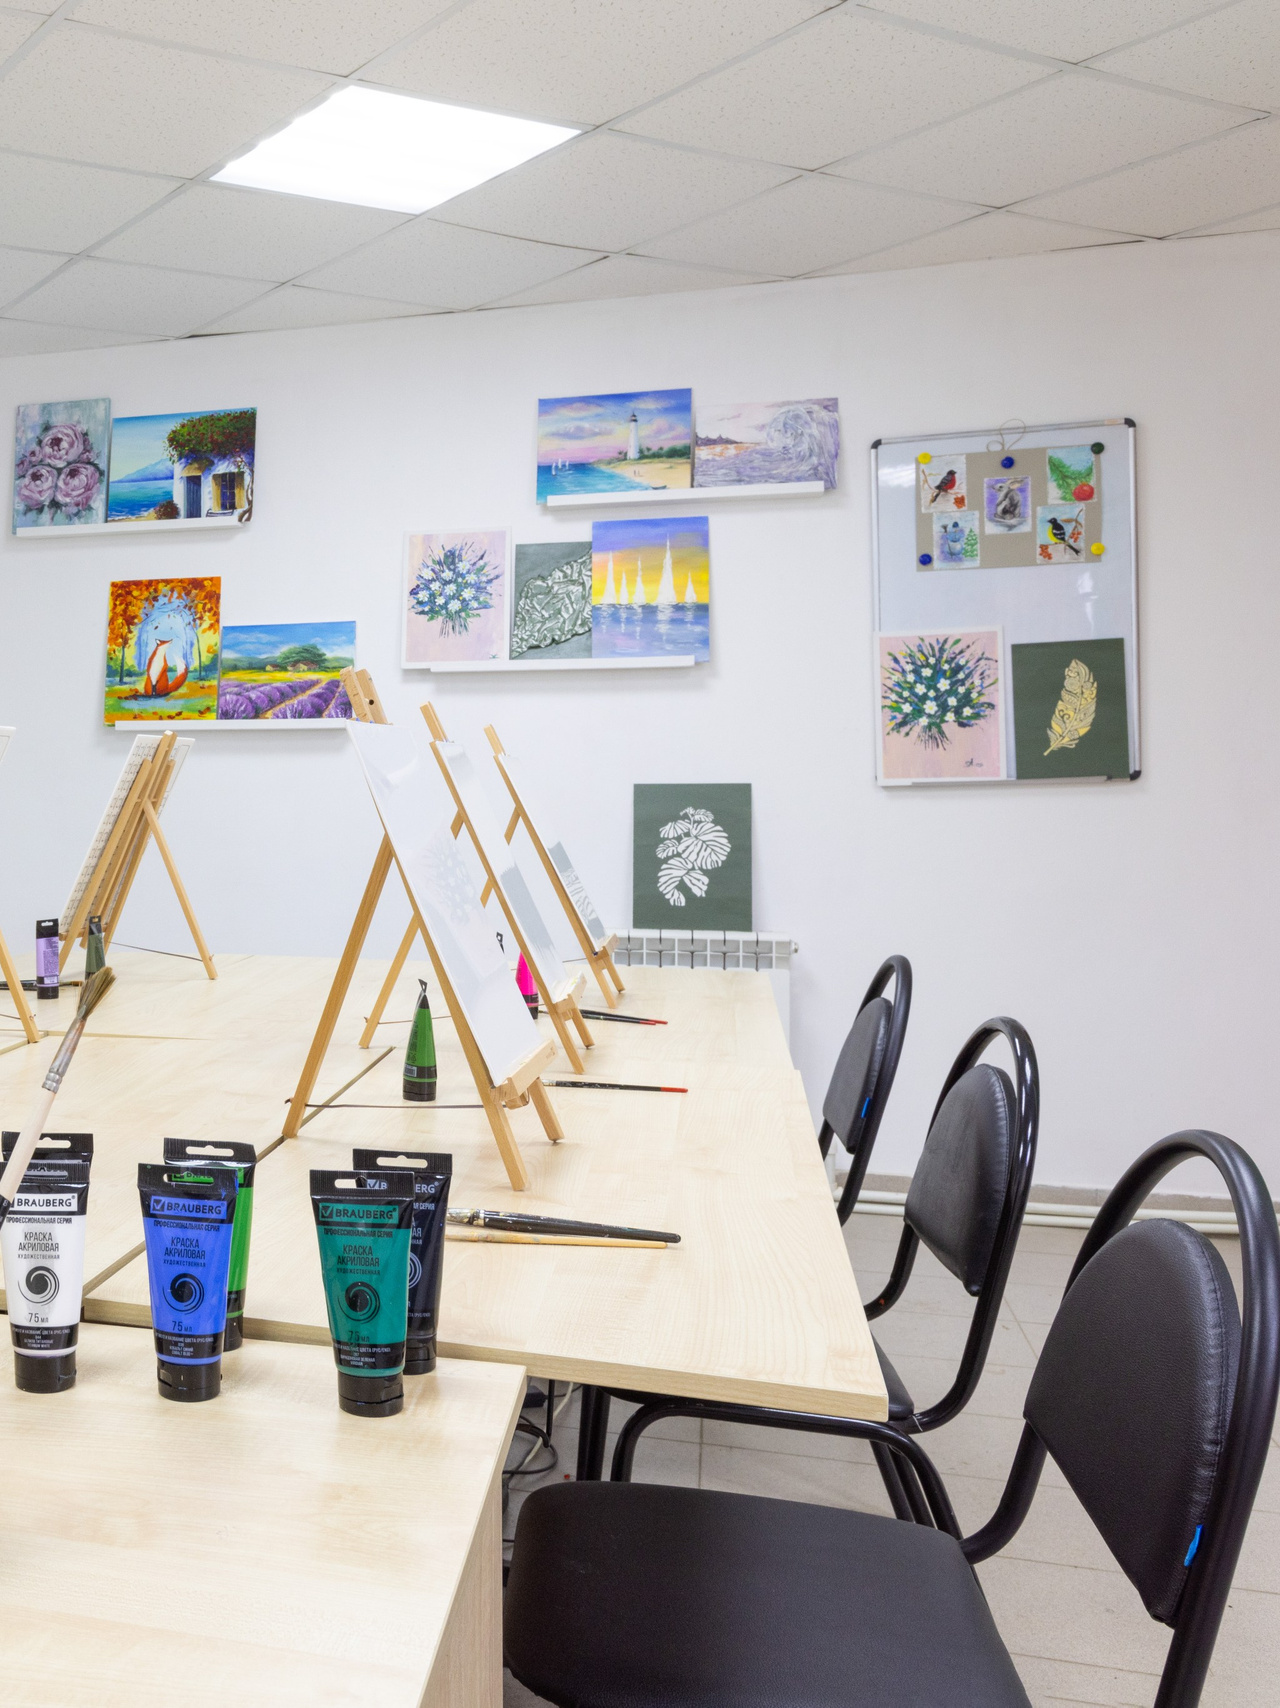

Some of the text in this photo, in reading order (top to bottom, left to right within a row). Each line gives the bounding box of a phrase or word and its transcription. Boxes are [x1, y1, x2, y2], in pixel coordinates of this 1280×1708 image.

[17, 1198, 72, 1207] BRAUBERG
[166, 1203, 222, 1214] BRAUBERG
[336, 1208, 393, 1220] BRAUBERG
[204, 1224, 220, 1232] СЕРИЯ
[24, 1232, 52, 1241] КРАСКА
[378, 1230, 392, 1238] СЕРИЯ
[18, 1242, 59, 1252] АКРИЛОВАЯ
[171, 1237, 199, 1248] КРАСКА
[164, 1247, 206, 1260] АКРИЛОВАЯ
[343, 1245, 372, 1256] КРАСКА
[337, 1256, 379, 1267] АКРИЛОВАЯ
[29, 1313, 40, 1323] 75
[172, 1321, 183, 1332] 75
